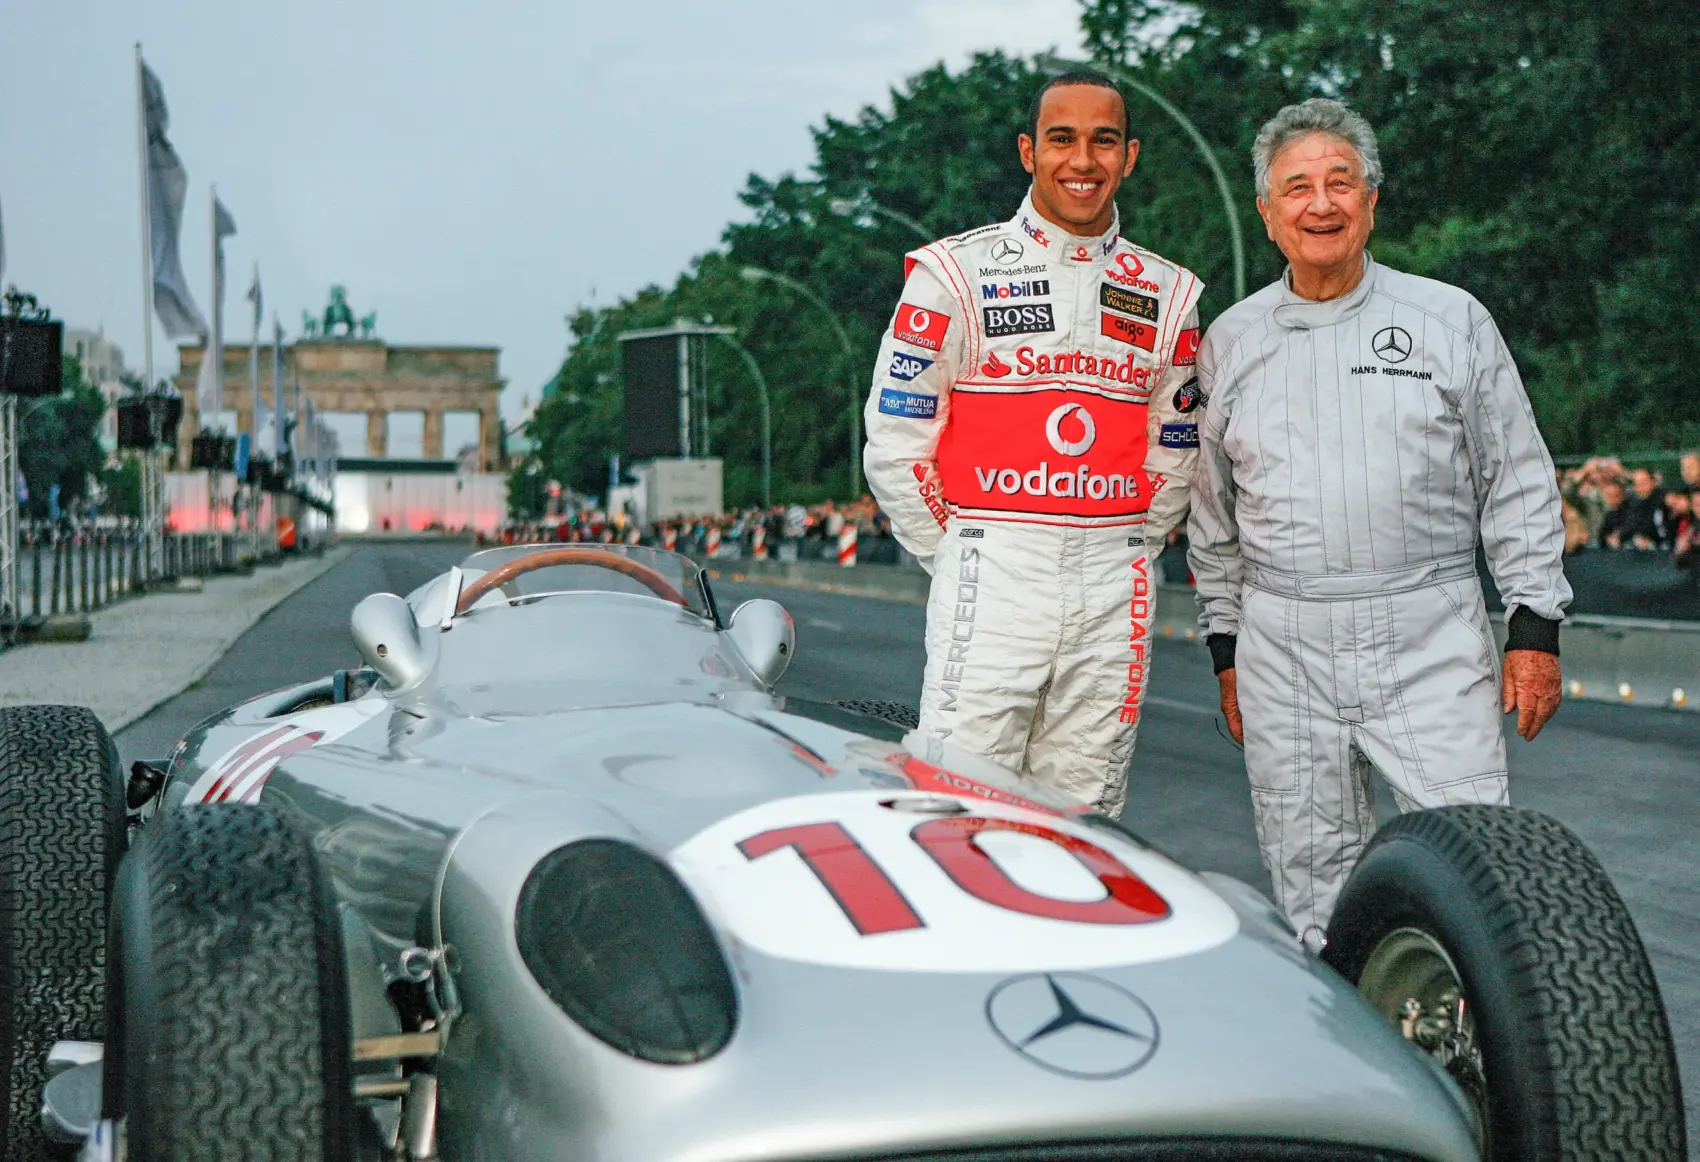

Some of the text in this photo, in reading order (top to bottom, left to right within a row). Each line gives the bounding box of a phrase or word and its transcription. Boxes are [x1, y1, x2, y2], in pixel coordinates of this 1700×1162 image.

[1021, 216, 1050, 248] FedEx
[979, 264, 1047, 277] Mercedes-Benz
[981, 281, 1031, 299] Mobil
[1104, 269, 1159, 293] vodafone
[1105, 288, 1143, 306] JOHNNIE
[1106, 296, 1143, 312] WALKER
[987, 307, 1050, 327] BOSS
[898, 331, 936, 347] vodafone
[1114, 319, 1144, 342] aigo
[891, 356, 922, 377] SAP
[1016, 346, 1151, 389] Santander
[1351, 366, 1432, 380] HANS HERRMANN
[906, 397, 934, 408] MUTUA
[1163, 428, 1198, 442] SCHÜC
[974, 462, 1138, 500] vodafone
[938, 547, 981, 712] MERCEDES
[1119, 556, 1148, 725] VODAFONE
[735, 816, 1173, 936] 10
